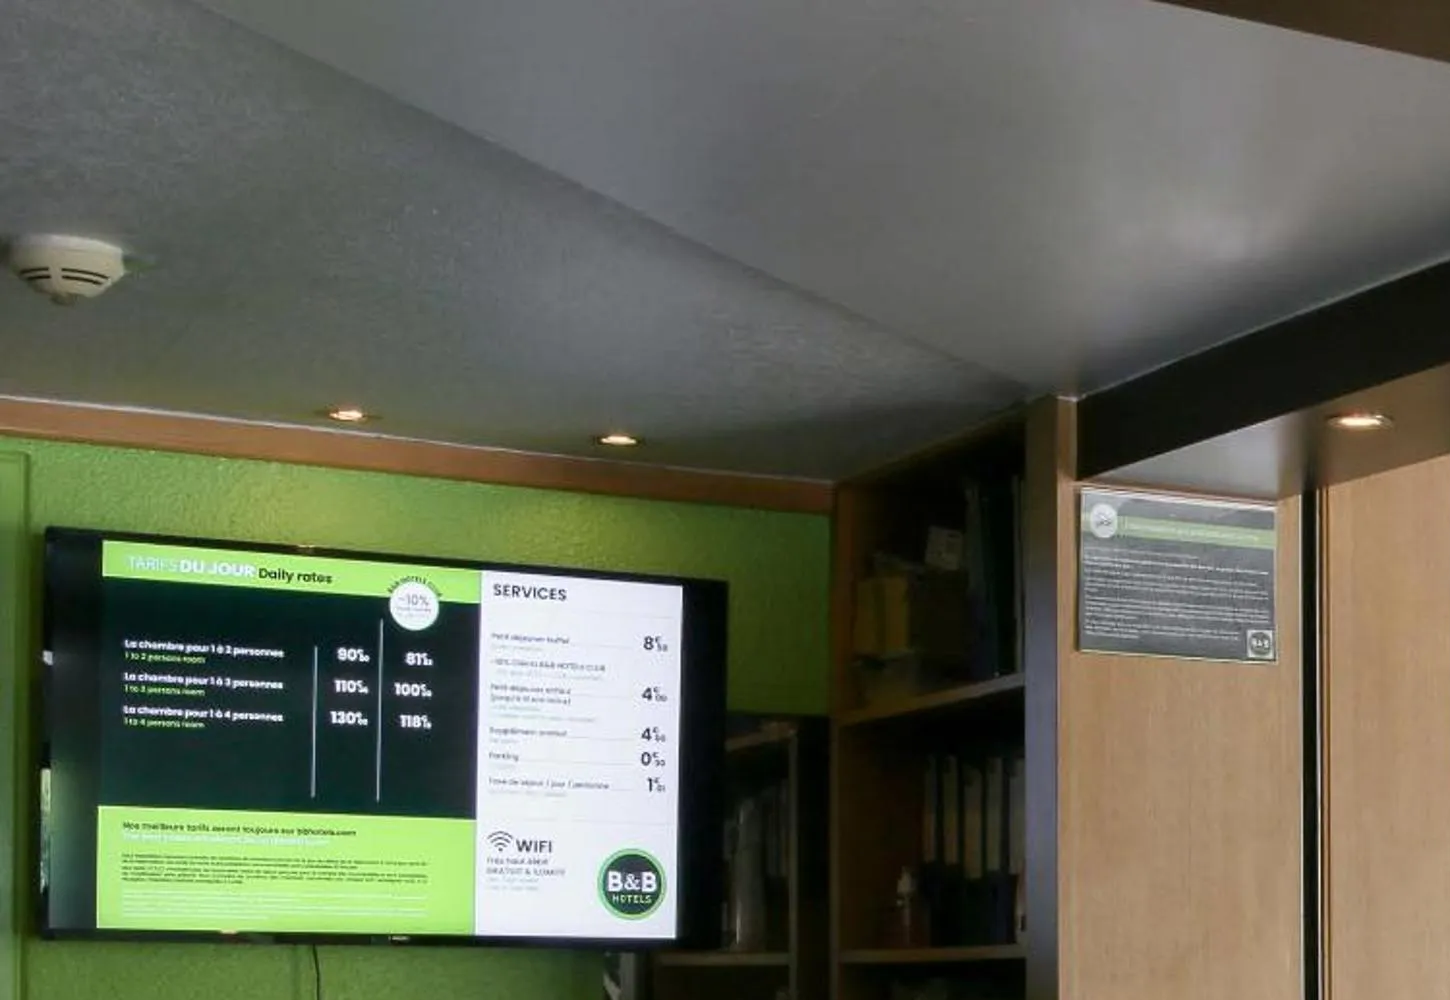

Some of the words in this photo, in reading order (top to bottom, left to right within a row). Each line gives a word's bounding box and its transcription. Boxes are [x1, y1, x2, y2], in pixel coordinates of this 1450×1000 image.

[179, 560, 204, 574] DU
[205, 563, 256, 578] JOUR
[258, 568, 294, 584] Daily
[297, 572, 333, 585] rates
[494, 584, 567, 601] SERVICES
[516, 840, 552, 853] WIFI
[607, 870, 657, 893] B&B
[612, 894, 652, 904] HOTELS
